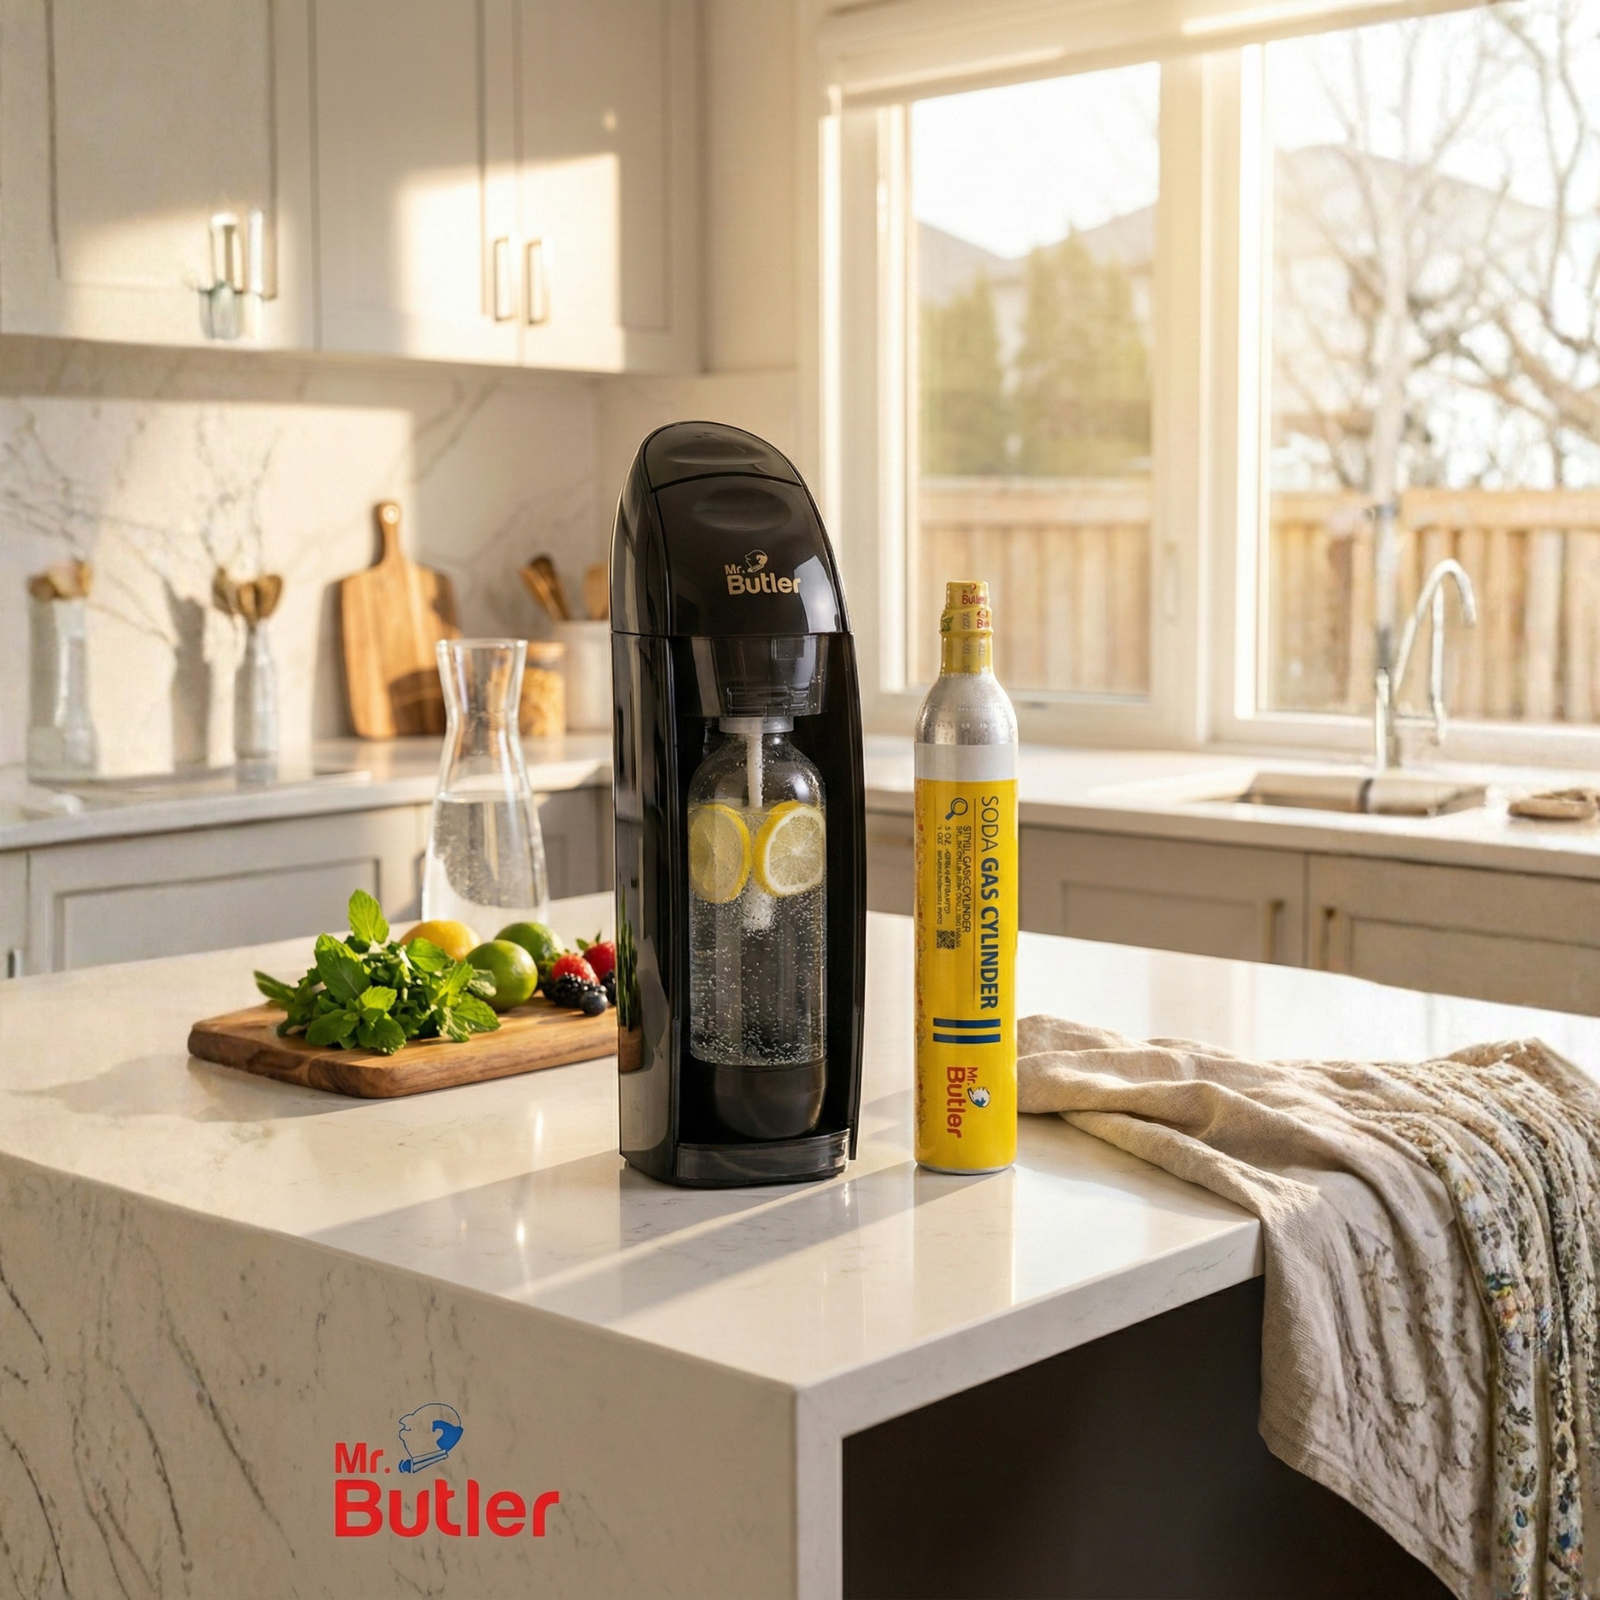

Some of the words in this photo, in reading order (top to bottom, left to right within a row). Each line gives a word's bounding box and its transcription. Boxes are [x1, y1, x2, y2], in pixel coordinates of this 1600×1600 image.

[724, 564, 746, 575] Mr.
[726, 572, 802, 595] Butler
[981, 795, 999, 853] SODA
[980, 857, 999, 901] GAS
[980, 906, 999, 1010] CYLINDER
[967, 1066, 978, 1086] Mr.
[946, 1066, 967, 1139] Butler
